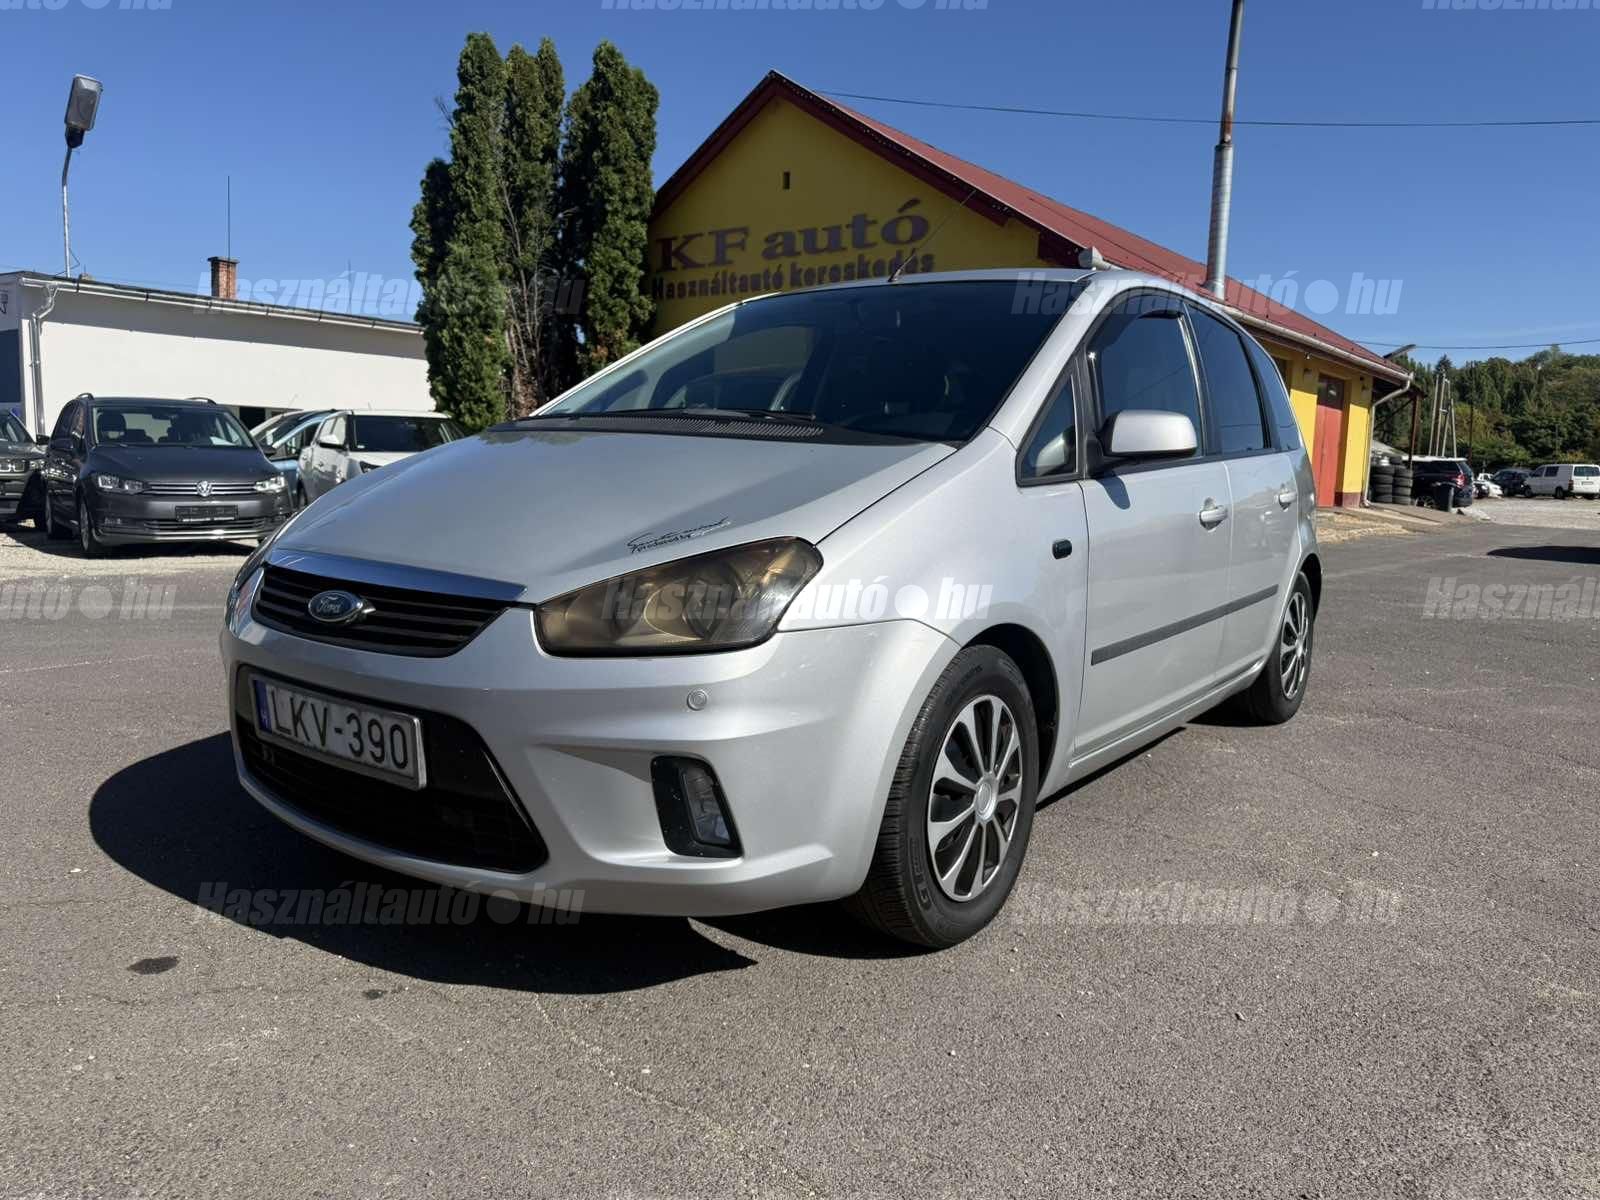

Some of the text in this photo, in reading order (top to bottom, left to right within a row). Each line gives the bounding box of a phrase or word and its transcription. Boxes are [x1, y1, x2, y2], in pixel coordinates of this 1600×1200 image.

[655, 198, 930, 272] KF autó
[652, 264, 784, 300] Használtautó
[315, 596, 344, 614] Ford
[271, 690, 409, 770] LKV-390
